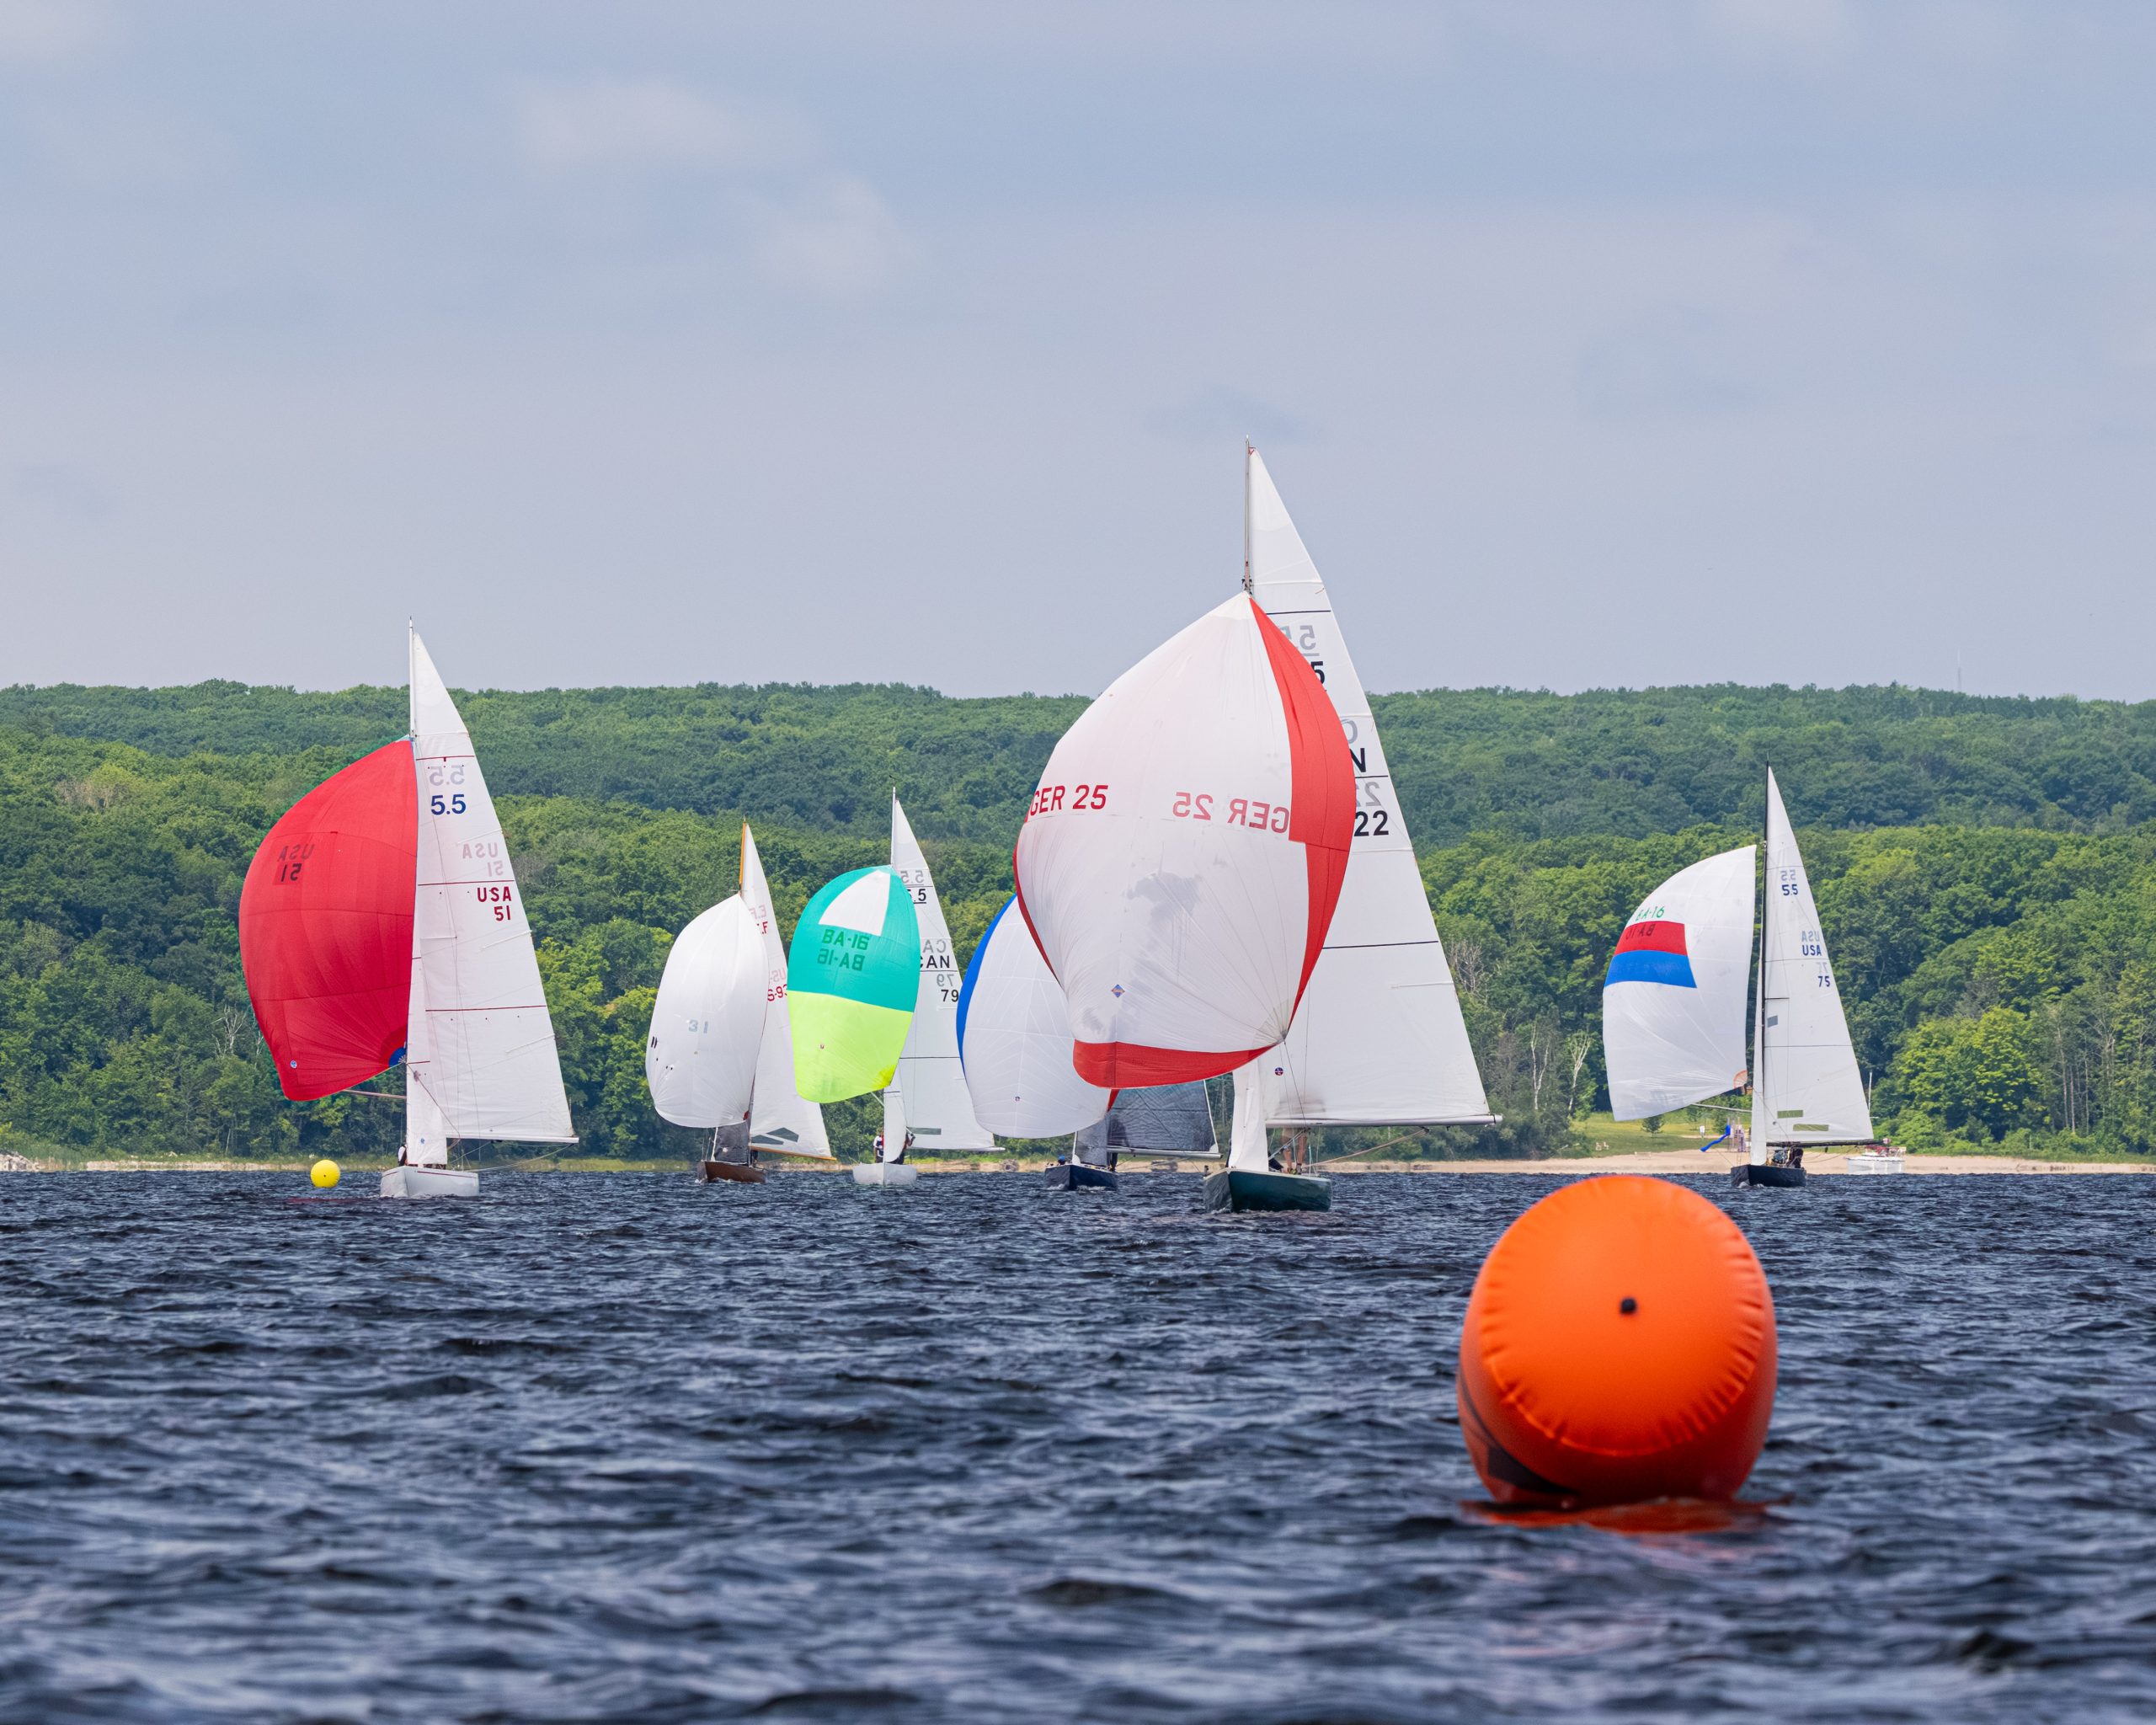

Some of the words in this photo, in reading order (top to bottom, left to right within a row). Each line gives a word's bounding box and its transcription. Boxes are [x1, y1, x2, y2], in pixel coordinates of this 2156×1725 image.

[430, 793, 467, 815] 5.5
[1029, 785, 1065, 816] GER
[1072, 784, 1108, 809] 25
[1353, 809, 1390, 837] 22
[477, 886, 512, 903] USA
[494, 905, 511, 921] 51
[1801, 944, 1822, 957] USA
[1817, 975, 1831, 988] 75
[941, 989, 959, 1002] 79
